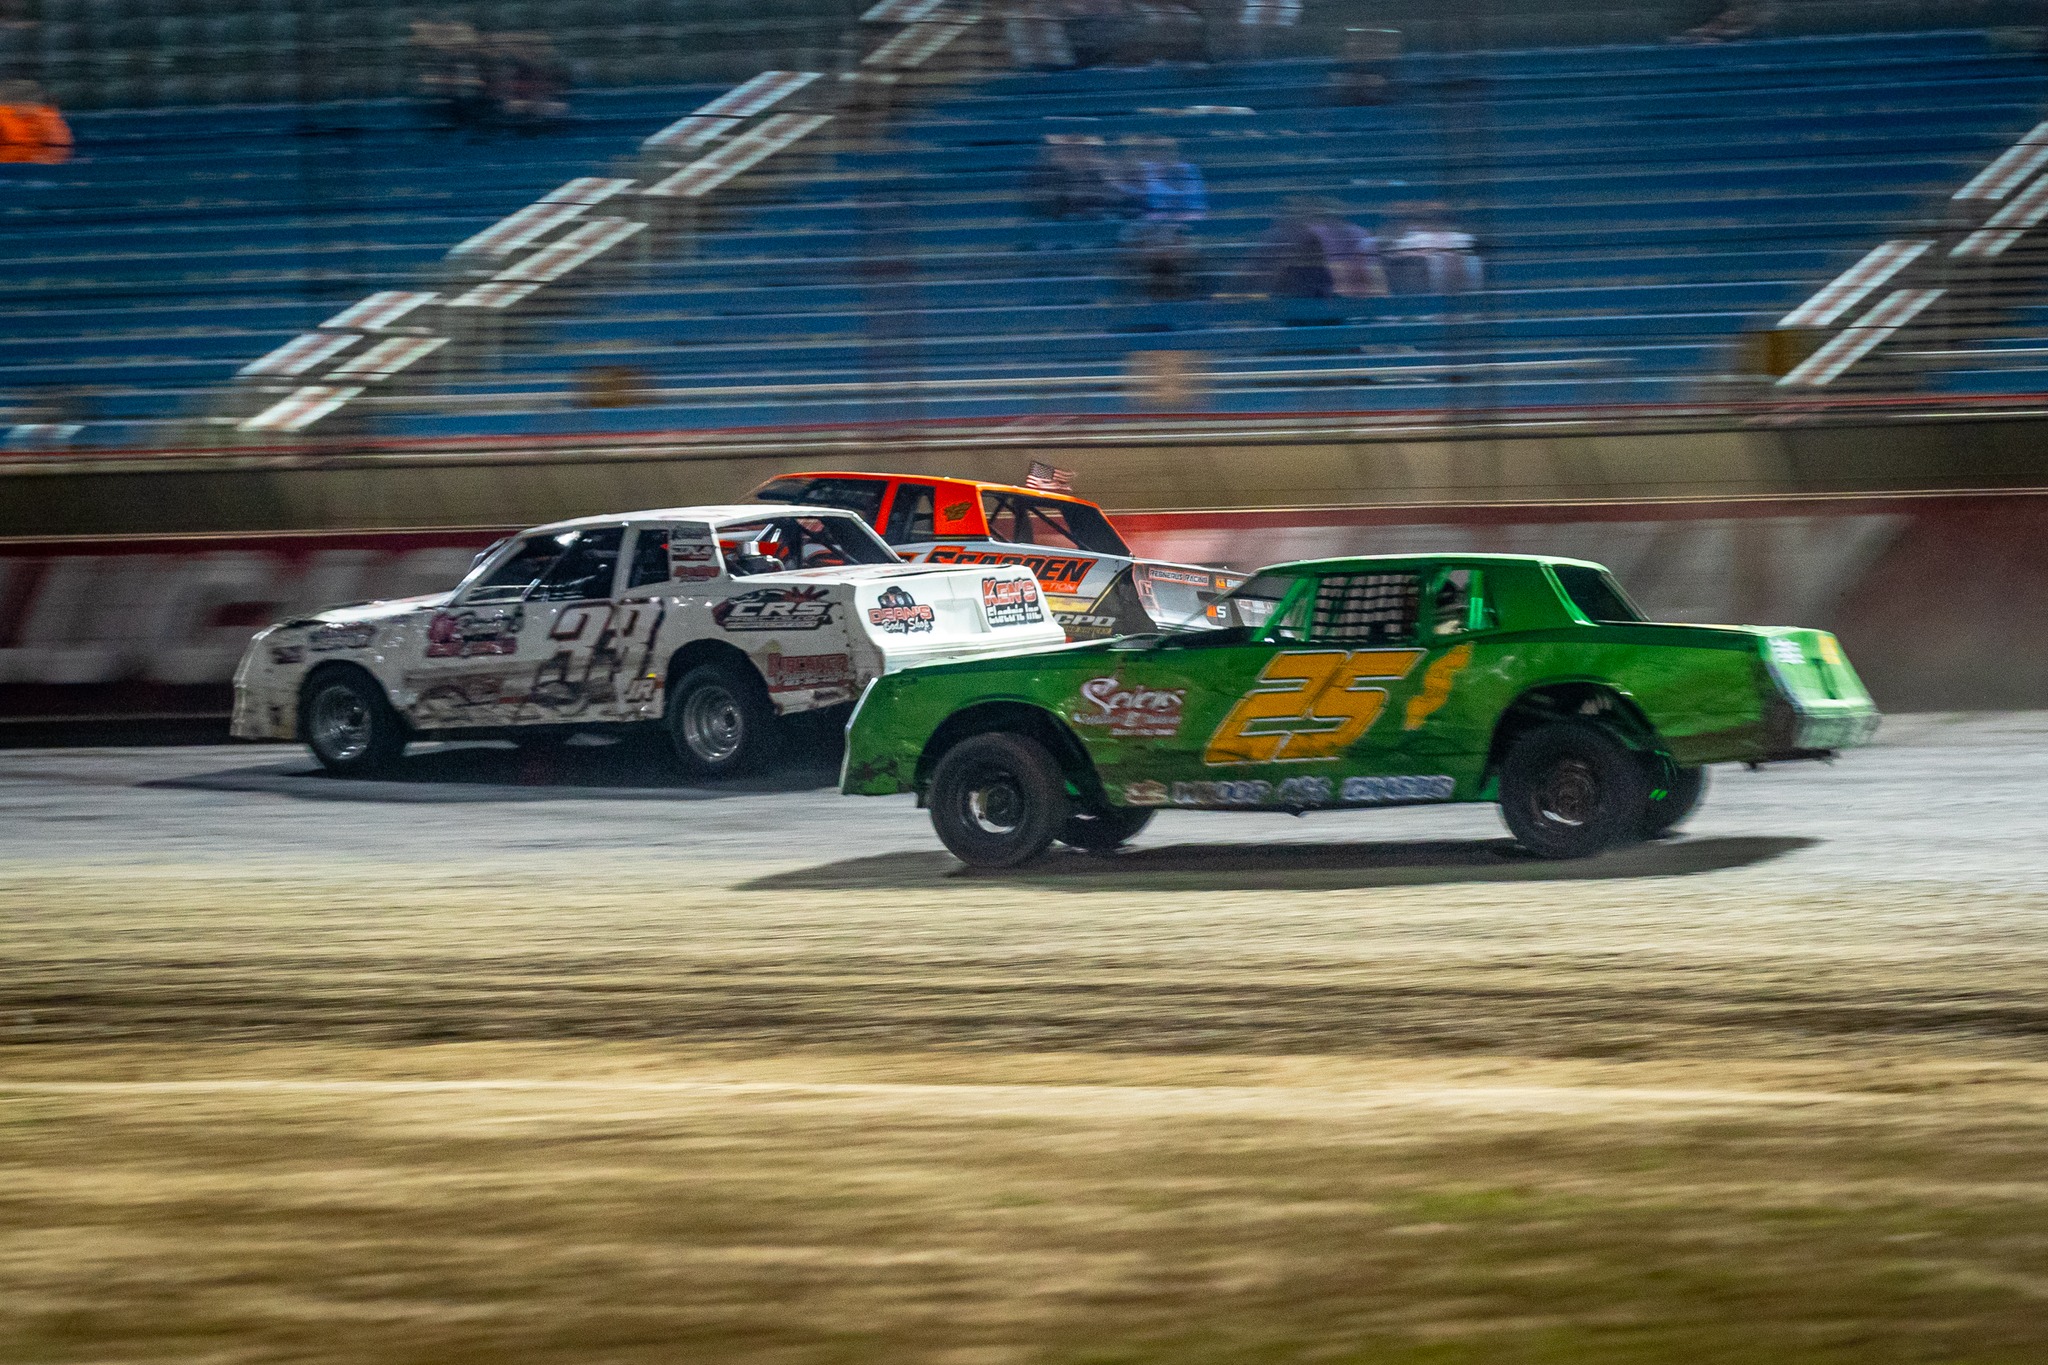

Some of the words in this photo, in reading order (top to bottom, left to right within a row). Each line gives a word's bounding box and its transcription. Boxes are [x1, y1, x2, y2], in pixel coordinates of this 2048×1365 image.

[982, 577, 1038, 606] KEN'S
[731, 602, 829, 617] CRS
[868, 605, 933, 625] DEAN'S
[1205, 649, 1429, 766] 25
